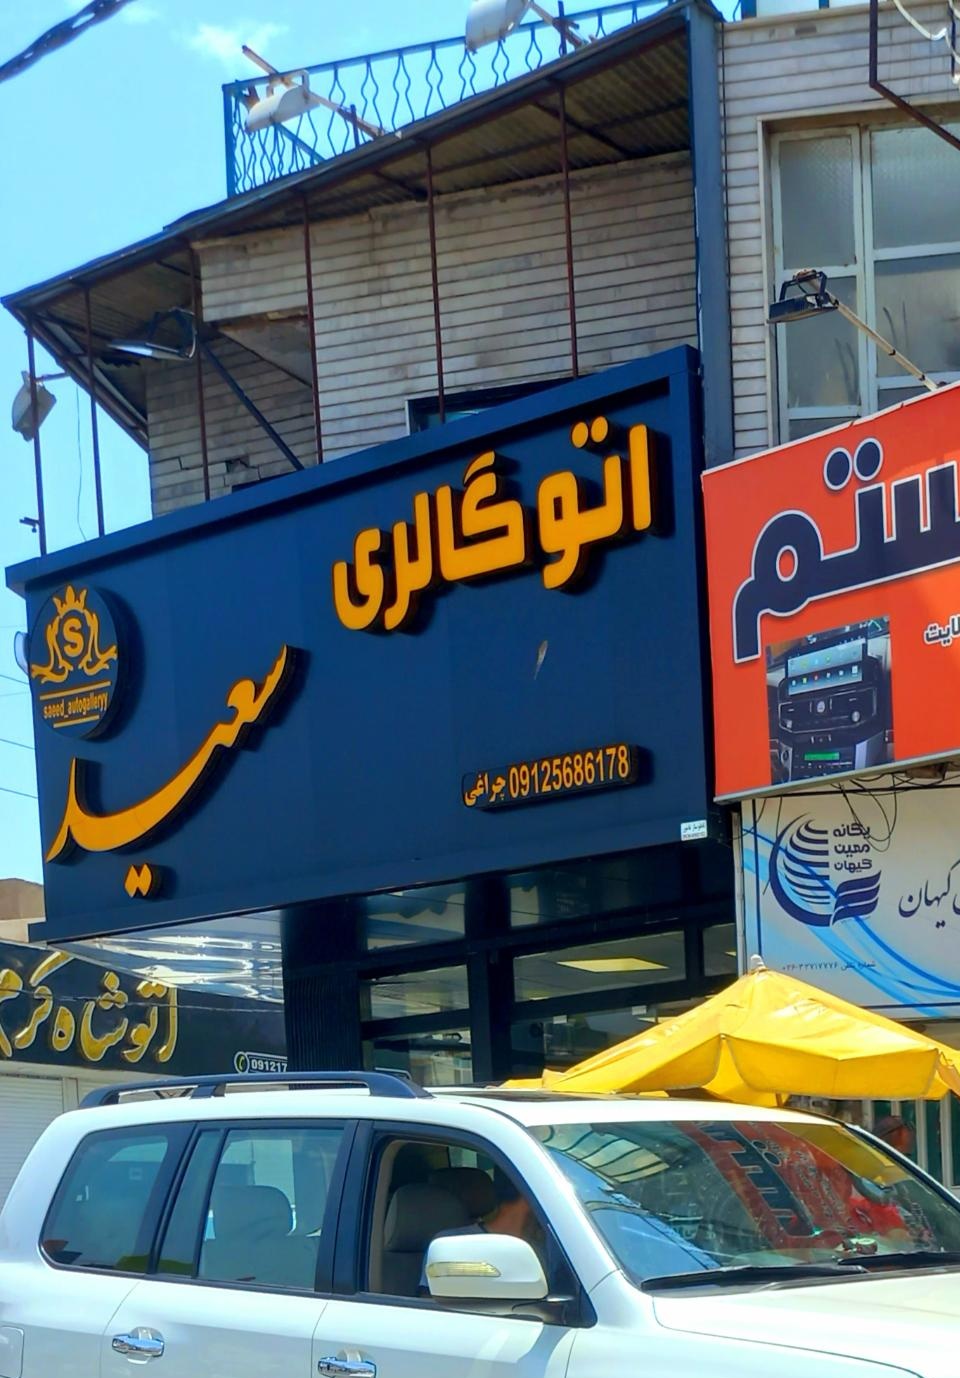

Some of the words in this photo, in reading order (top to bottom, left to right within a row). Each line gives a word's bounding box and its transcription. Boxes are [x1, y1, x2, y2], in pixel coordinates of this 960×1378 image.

[62, 617, 85, 658] S
[45, 644, 290, 900] سعید
[464, 773, 507, 807] چراغی
[509, 744, 630, 799] 09125686178
[833, 842, 871, 856] معین
[833, 858, 873, 874] کیهان
